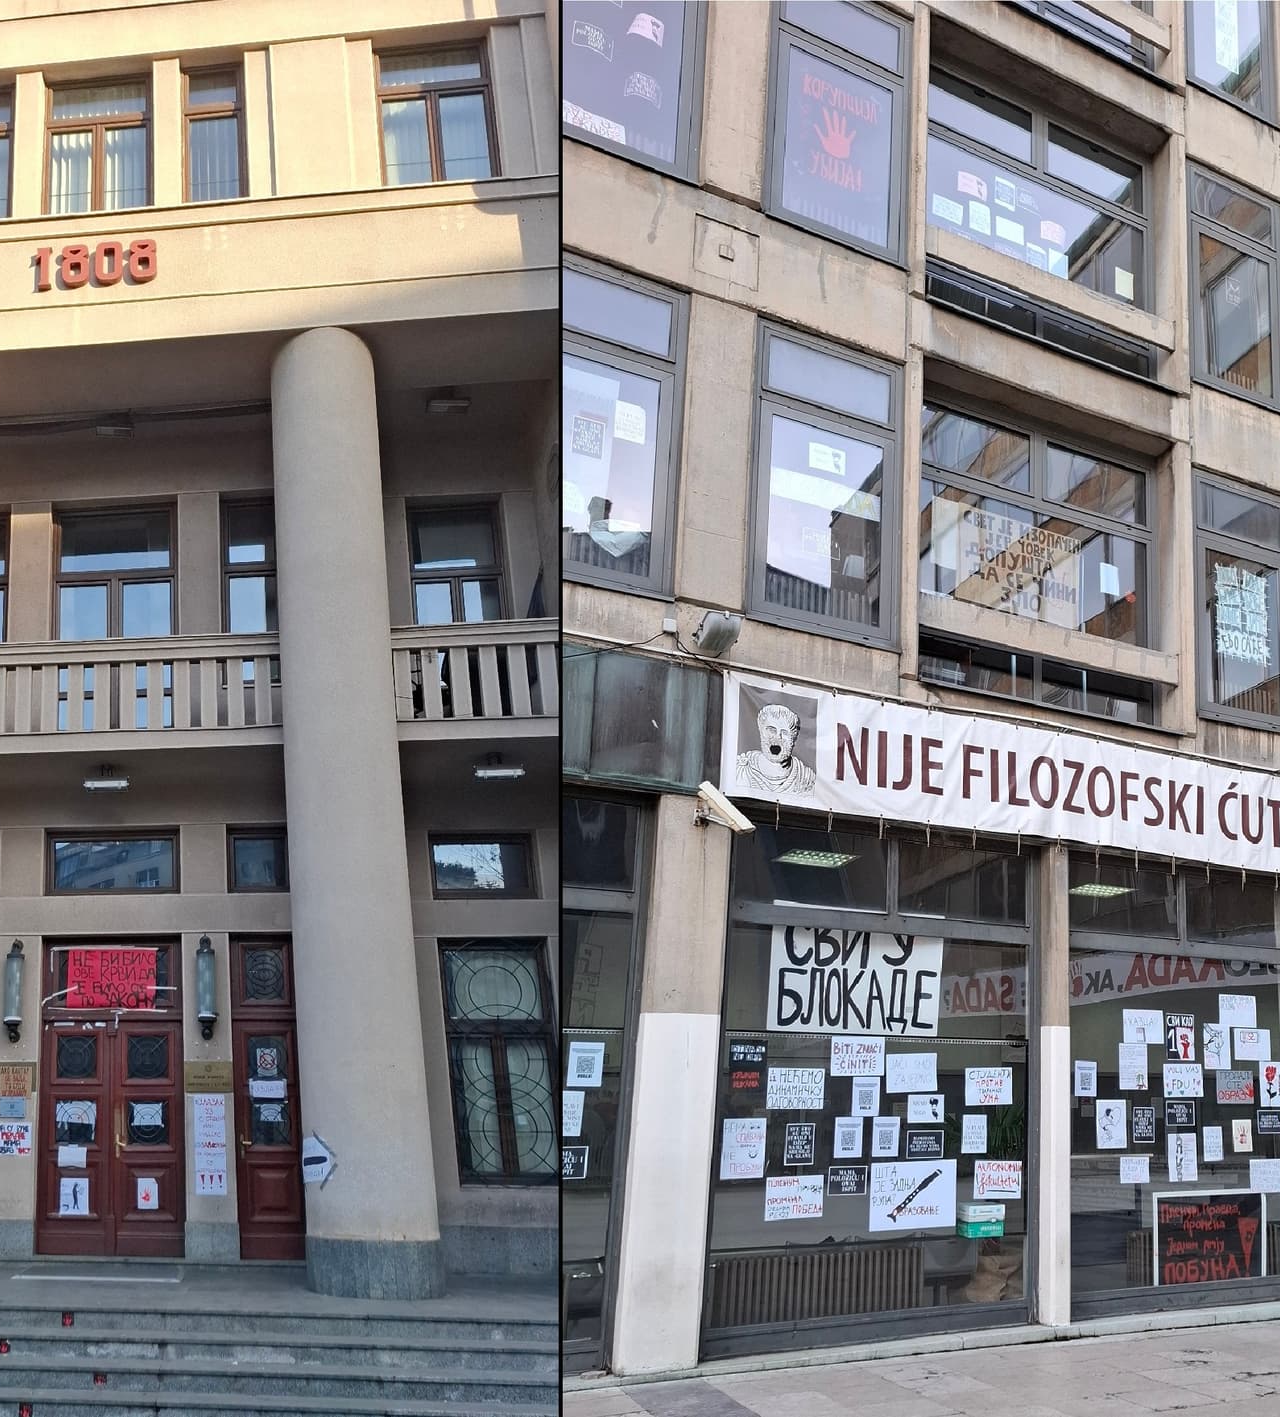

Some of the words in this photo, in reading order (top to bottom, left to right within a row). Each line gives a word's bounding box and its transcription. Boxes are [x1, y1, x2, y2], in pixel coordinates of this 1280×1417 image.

[36, 239, 157, 292] 1808
[963, 510, 996, 529] СВЕТ
[836, 723, 944, 796] NIJE
[962, 744, 1204, 835] FILOZOFSKI
[72, 951, 94, 967] НЕ
[101, 950, 119, 966] БИ
[122, 951, 157, 966] БИЛО
[784, 925, 871, 969] СВИ
[882, 935, 915, 966] У
[73, 967, 94, 979] ОВЕ
[777, 967, 938, 1034] БЛОКАДЕ
[1182, 1015, 1193, 1027] КАО
